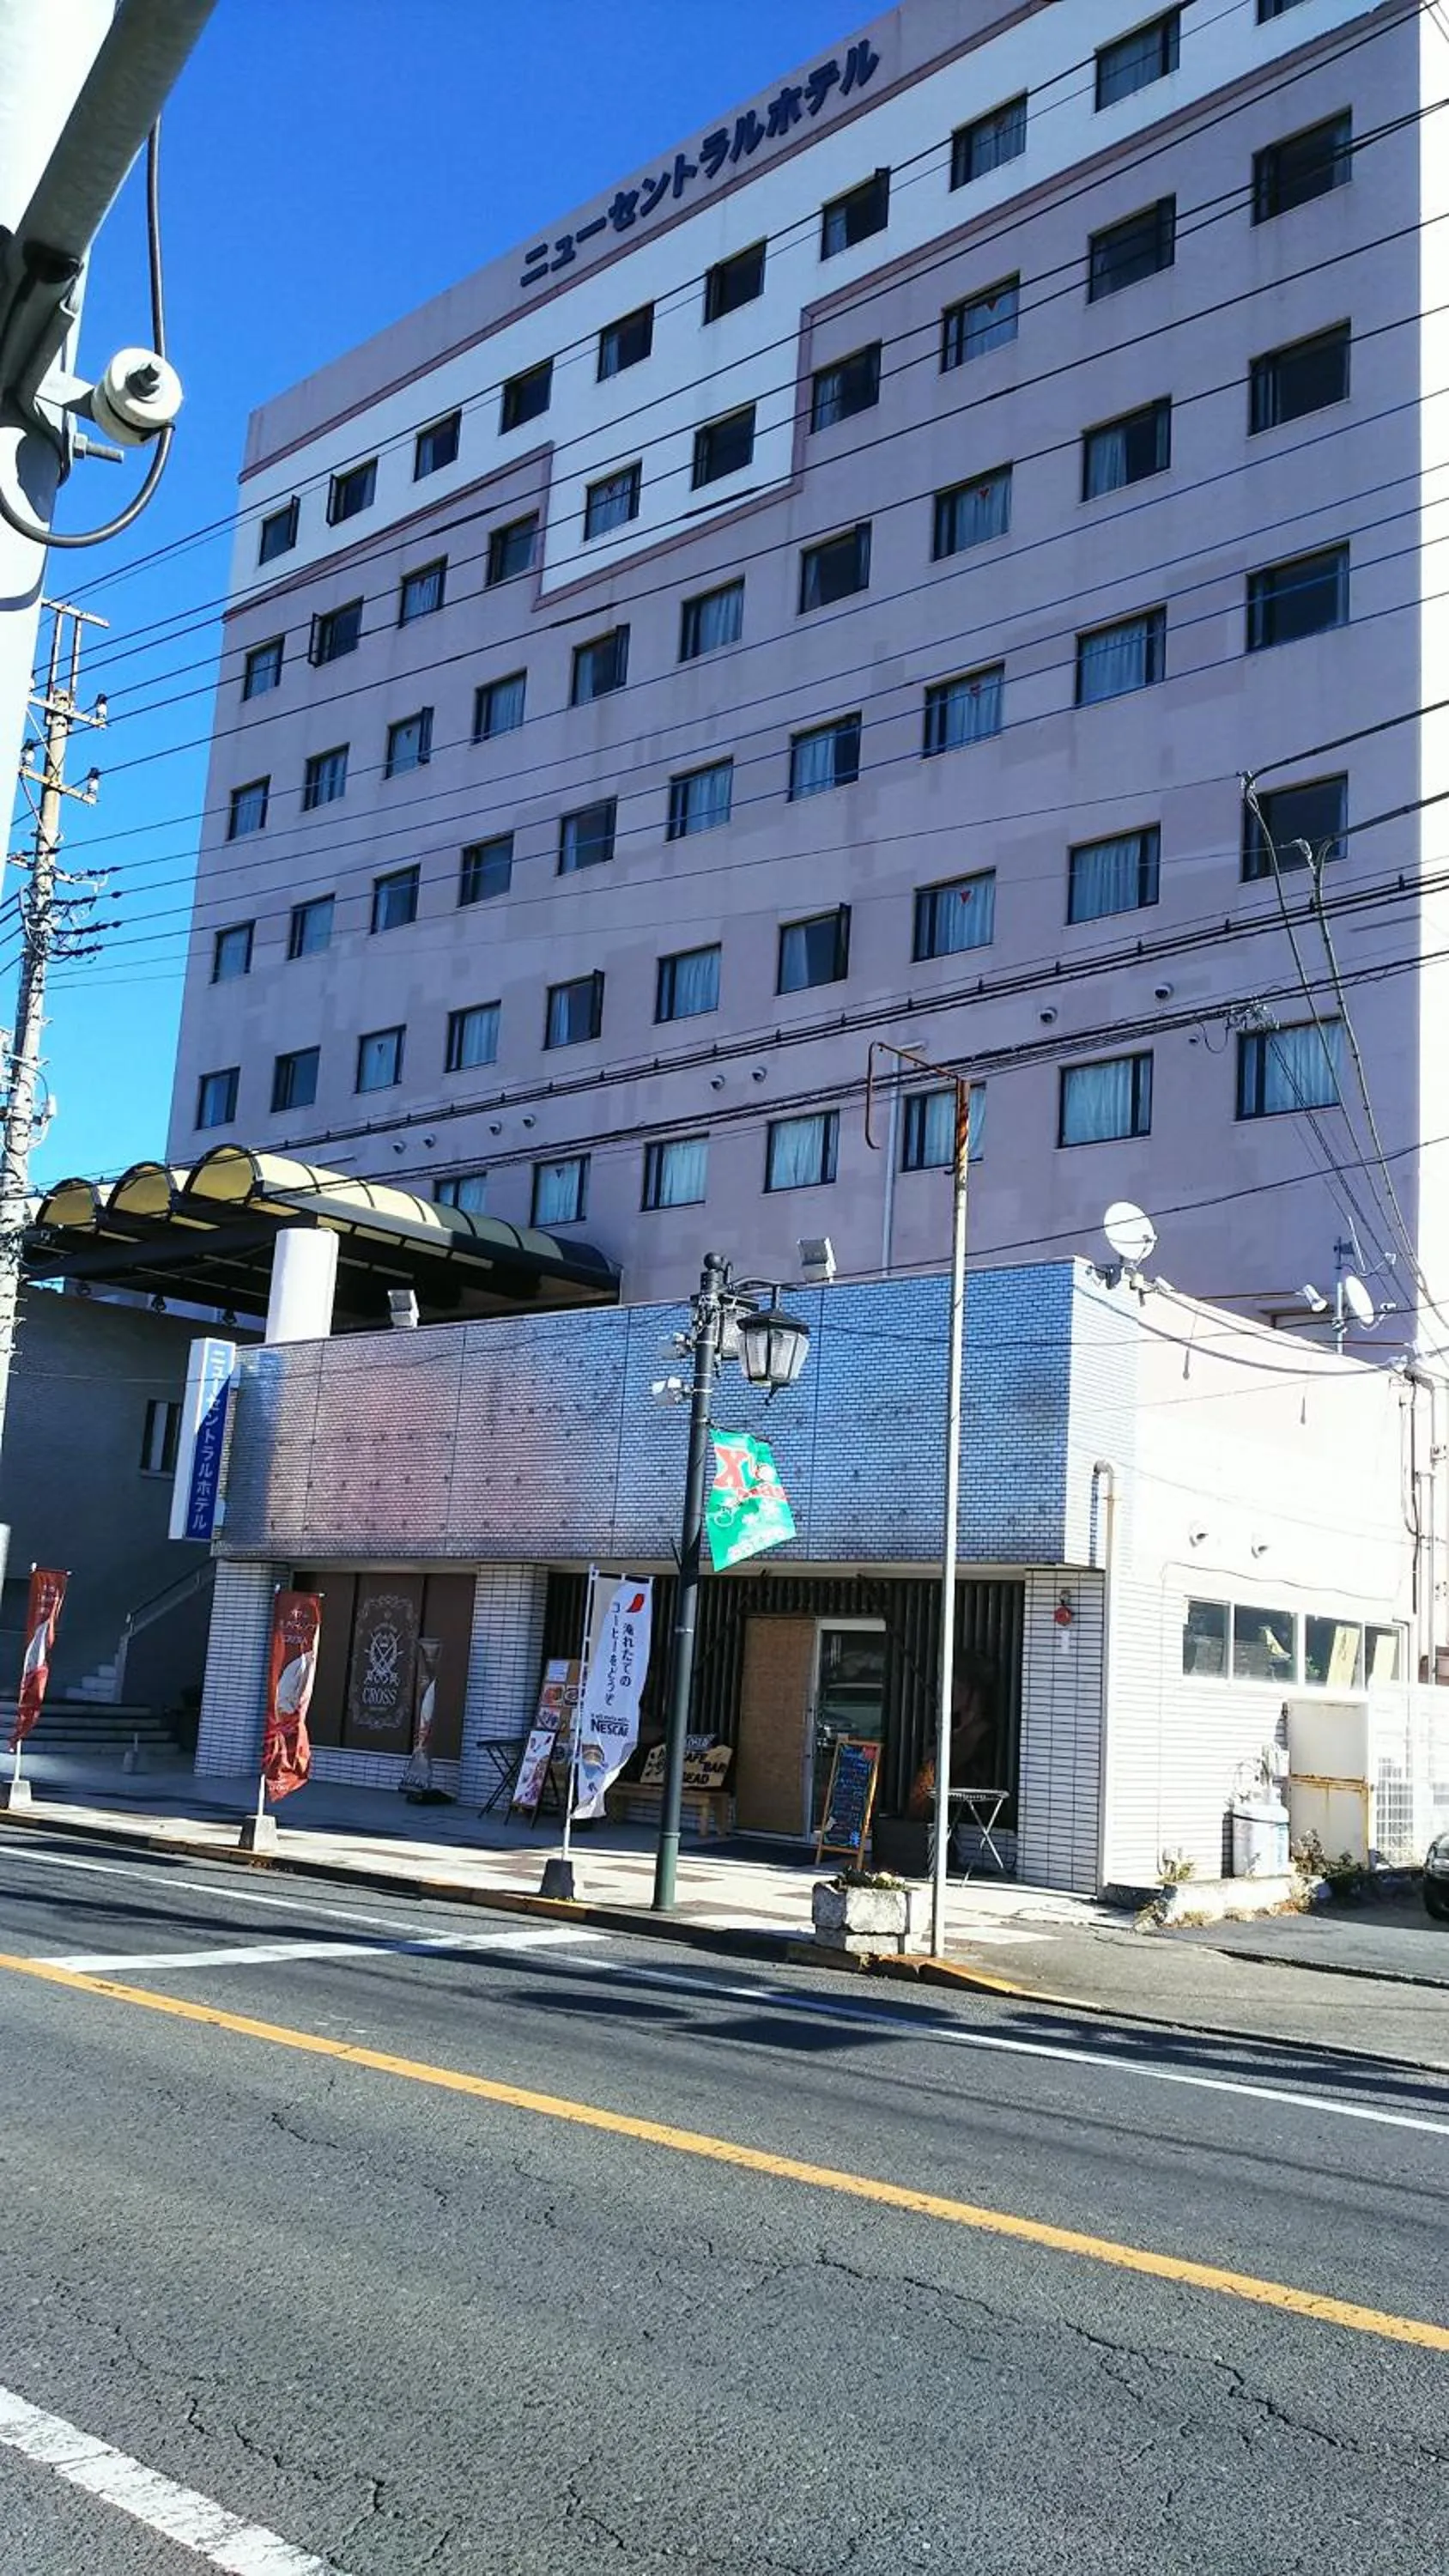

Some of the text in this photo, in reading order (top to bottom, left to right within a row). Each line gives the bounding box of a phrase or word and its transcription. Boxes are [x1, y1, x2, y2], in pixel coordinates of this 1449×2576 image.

[520, 39, 880, 288] ニューセントラルホテル
[191, 1350, 227, 1531] ニューセントラルホテル
[591, 1718, 629, 1737] NESCAF
